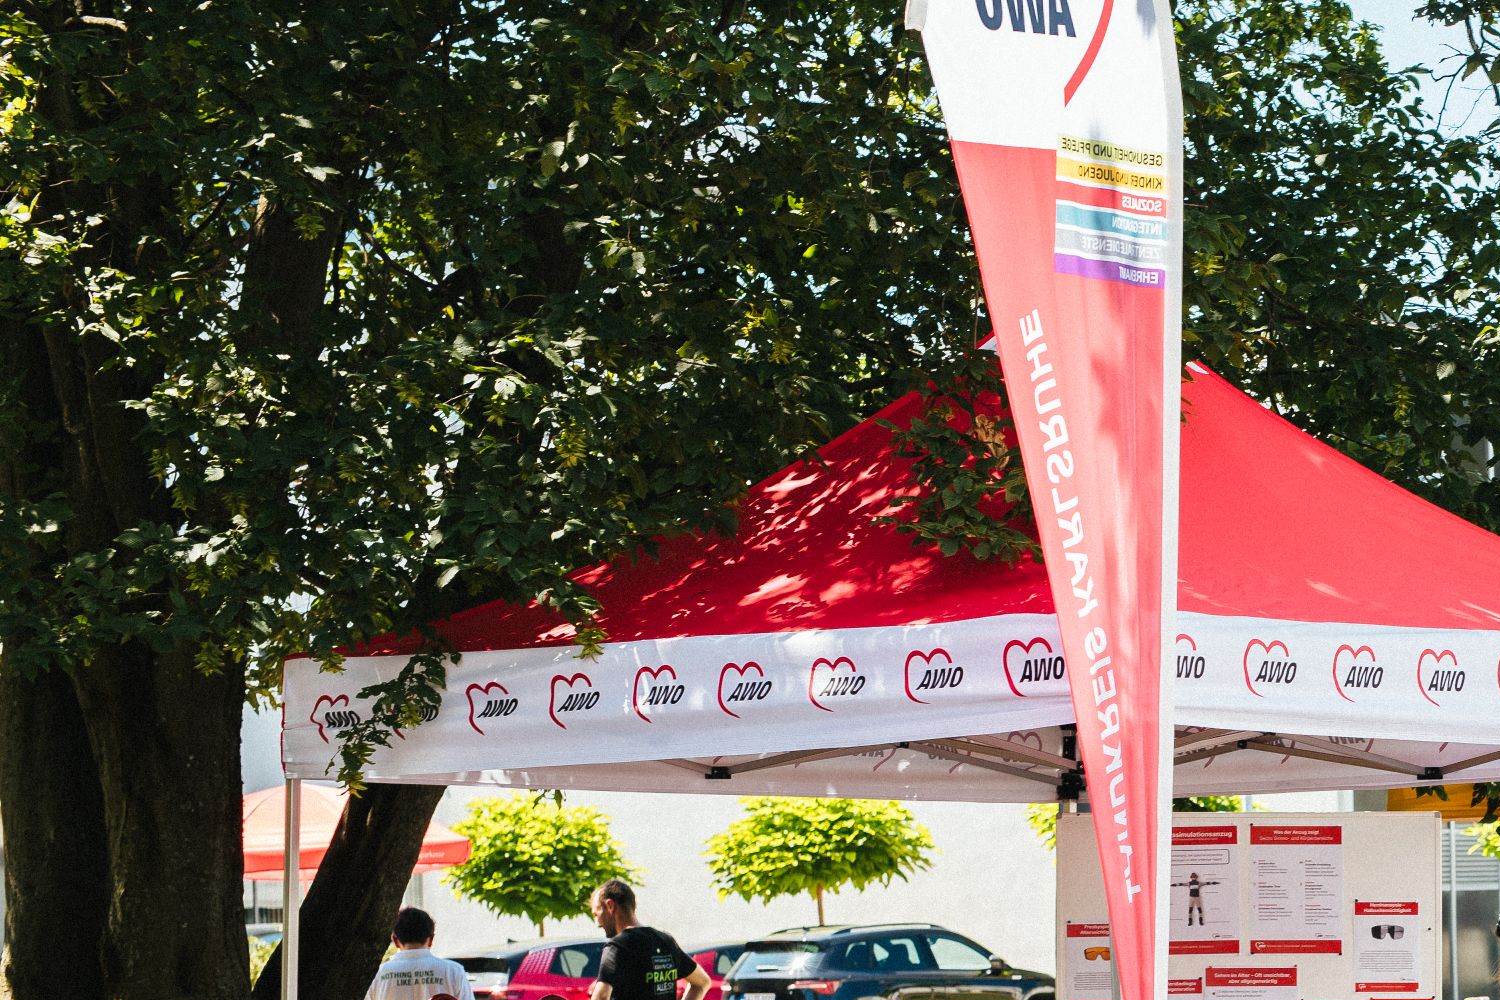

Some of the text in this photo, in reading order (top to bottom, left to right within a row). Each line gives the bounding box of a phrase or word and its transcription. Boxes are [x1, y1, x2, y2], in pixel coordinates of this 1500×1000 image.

[916, 666, 964, 690] AWO
[1020, 656, 1065, 683] AWO
[1176, 655, 1206, 679] WO
[1255, 660, 1297, 684] AWO
[1344, 665, 1384, 689] AWO
[727, 680, 772, 702] AWO
[819, 675, 866, 698] AWO
[1428, 670, 1465, 692] AWO
[556, 691, 600, 713] AWO
[642, 684, 685, 706] AWO
[325, 710, 361, 728] AWO
[477, 698, 518, 719] AWO
[381, 971, 412, 980] NOTHING
[397, 978, 412, 986] LIKE
